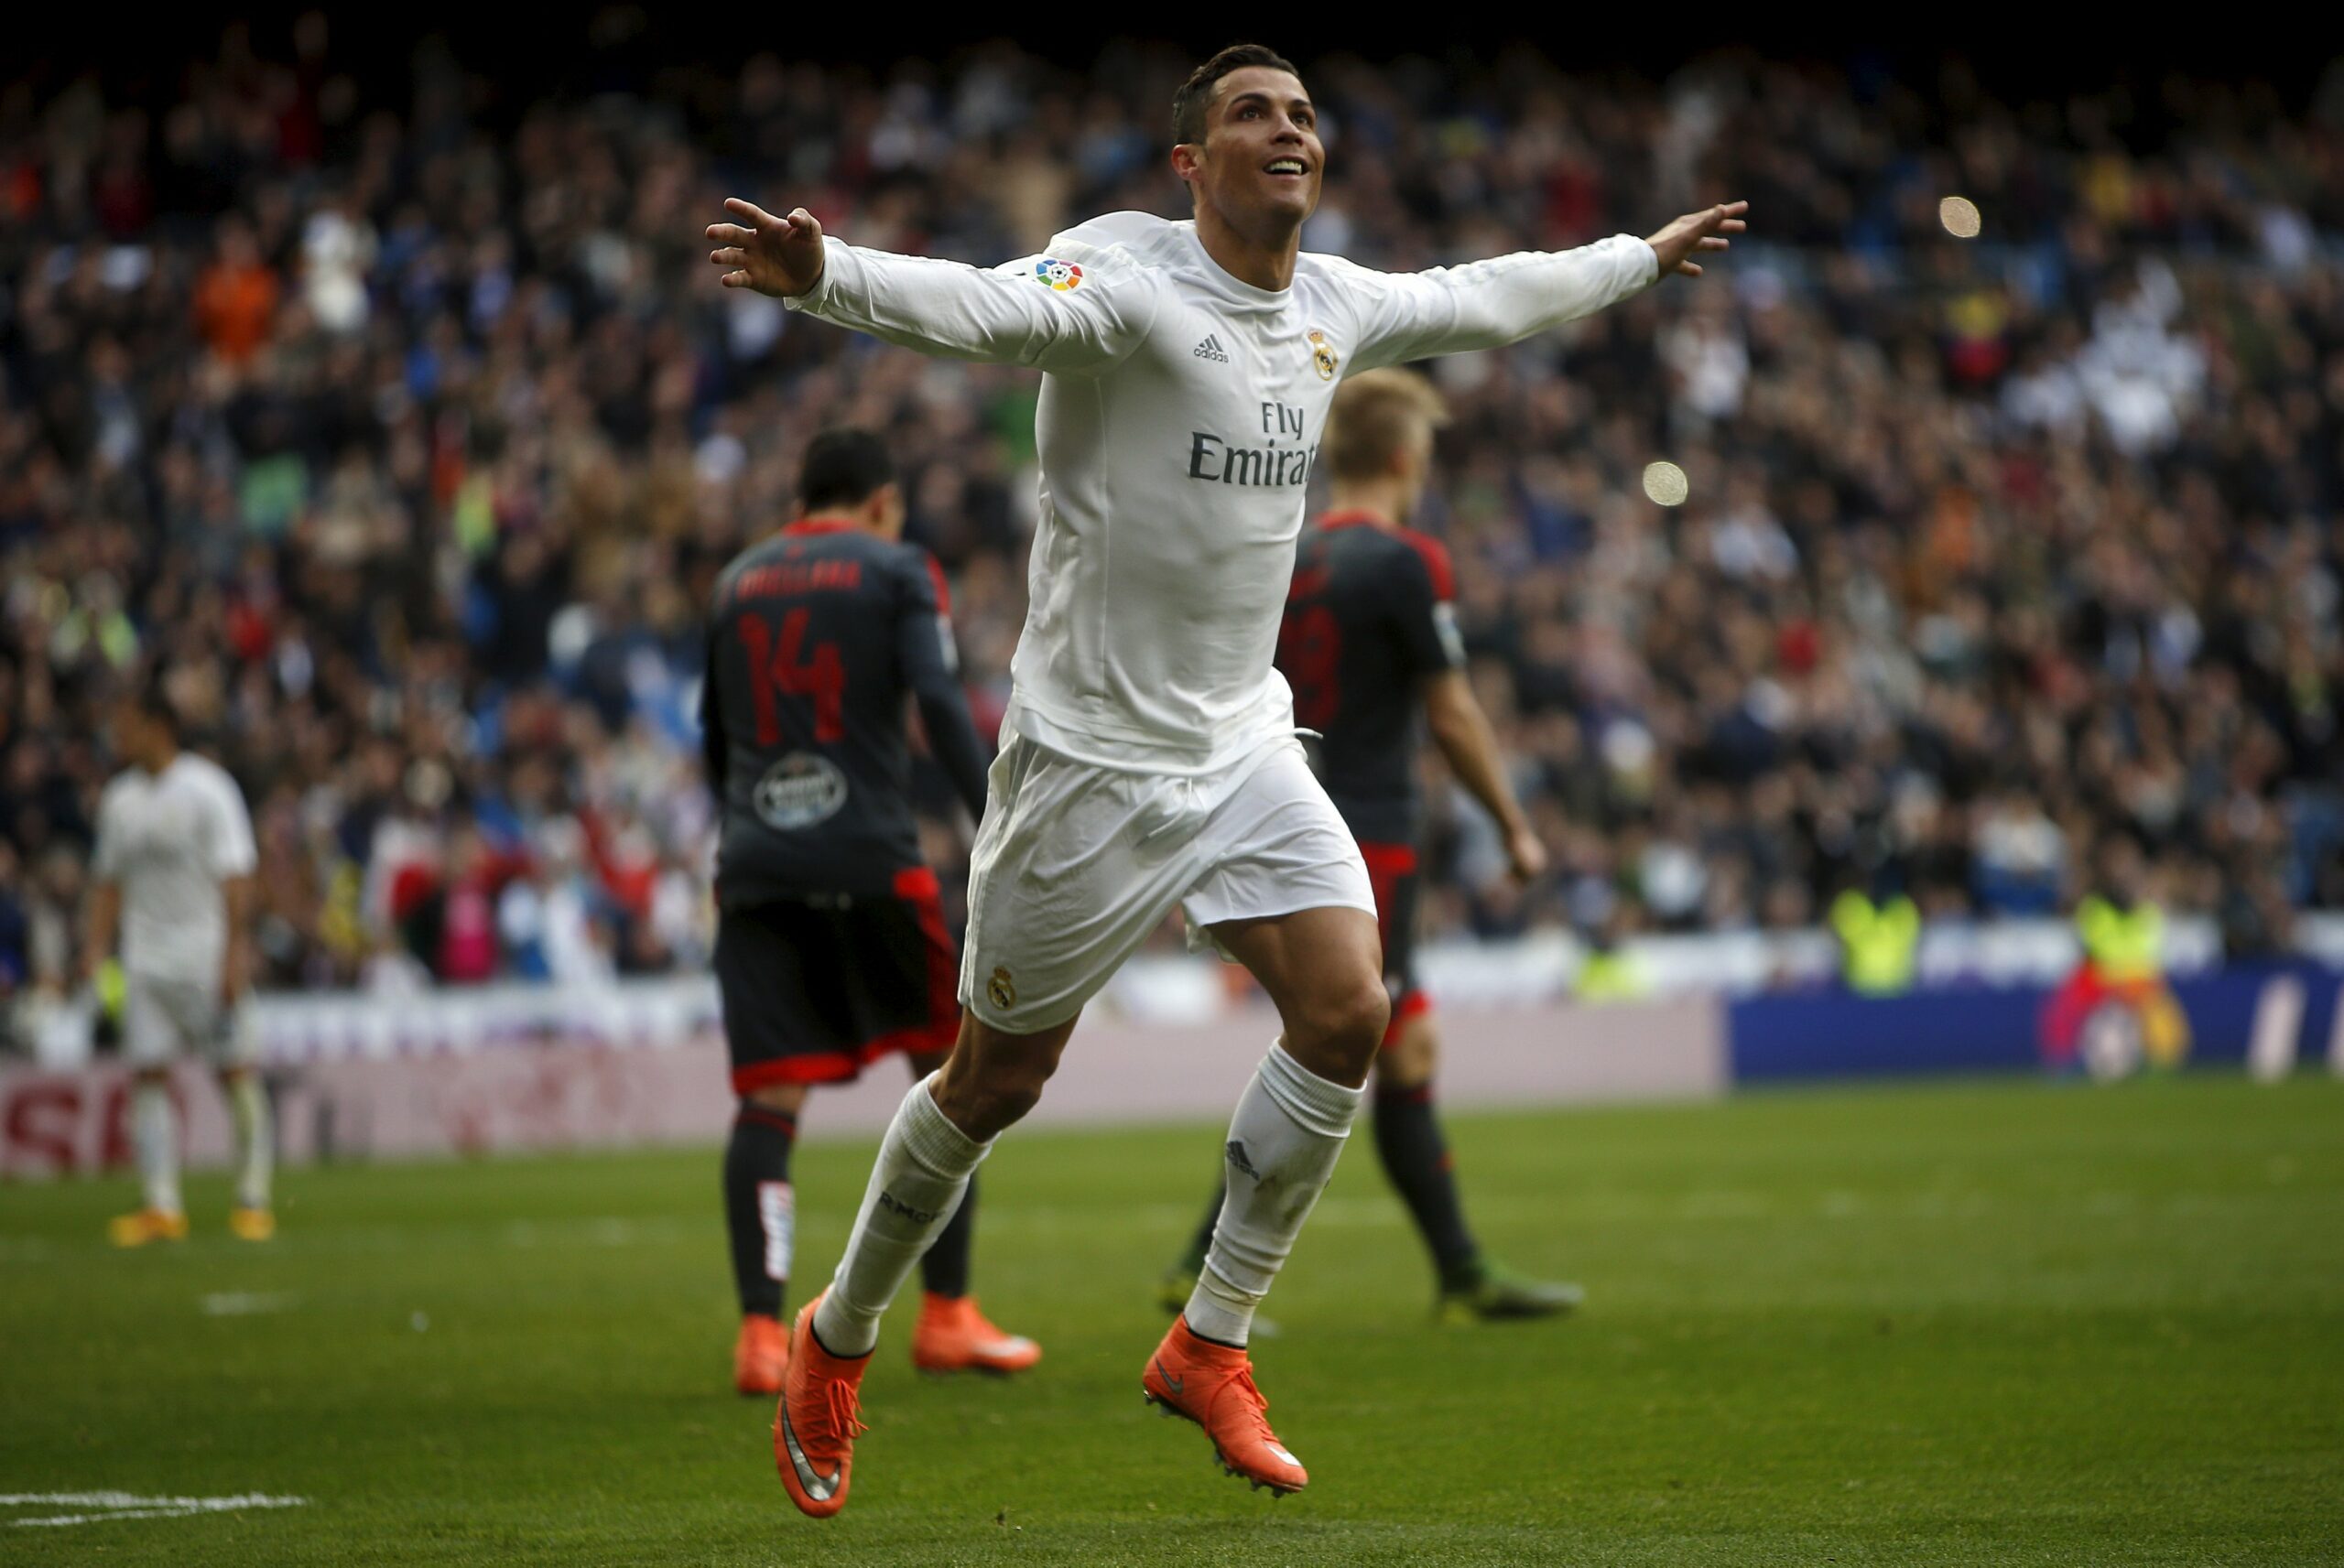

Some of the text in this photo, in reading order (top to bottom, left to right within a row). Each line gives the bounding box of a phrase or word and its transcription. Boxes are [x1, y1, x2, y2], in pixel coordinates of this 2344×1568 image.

[1194, 347, 1229, 363] adidas
[1262, 402, 1304, 440] Fly
[739, 607, 844, 746] 14
